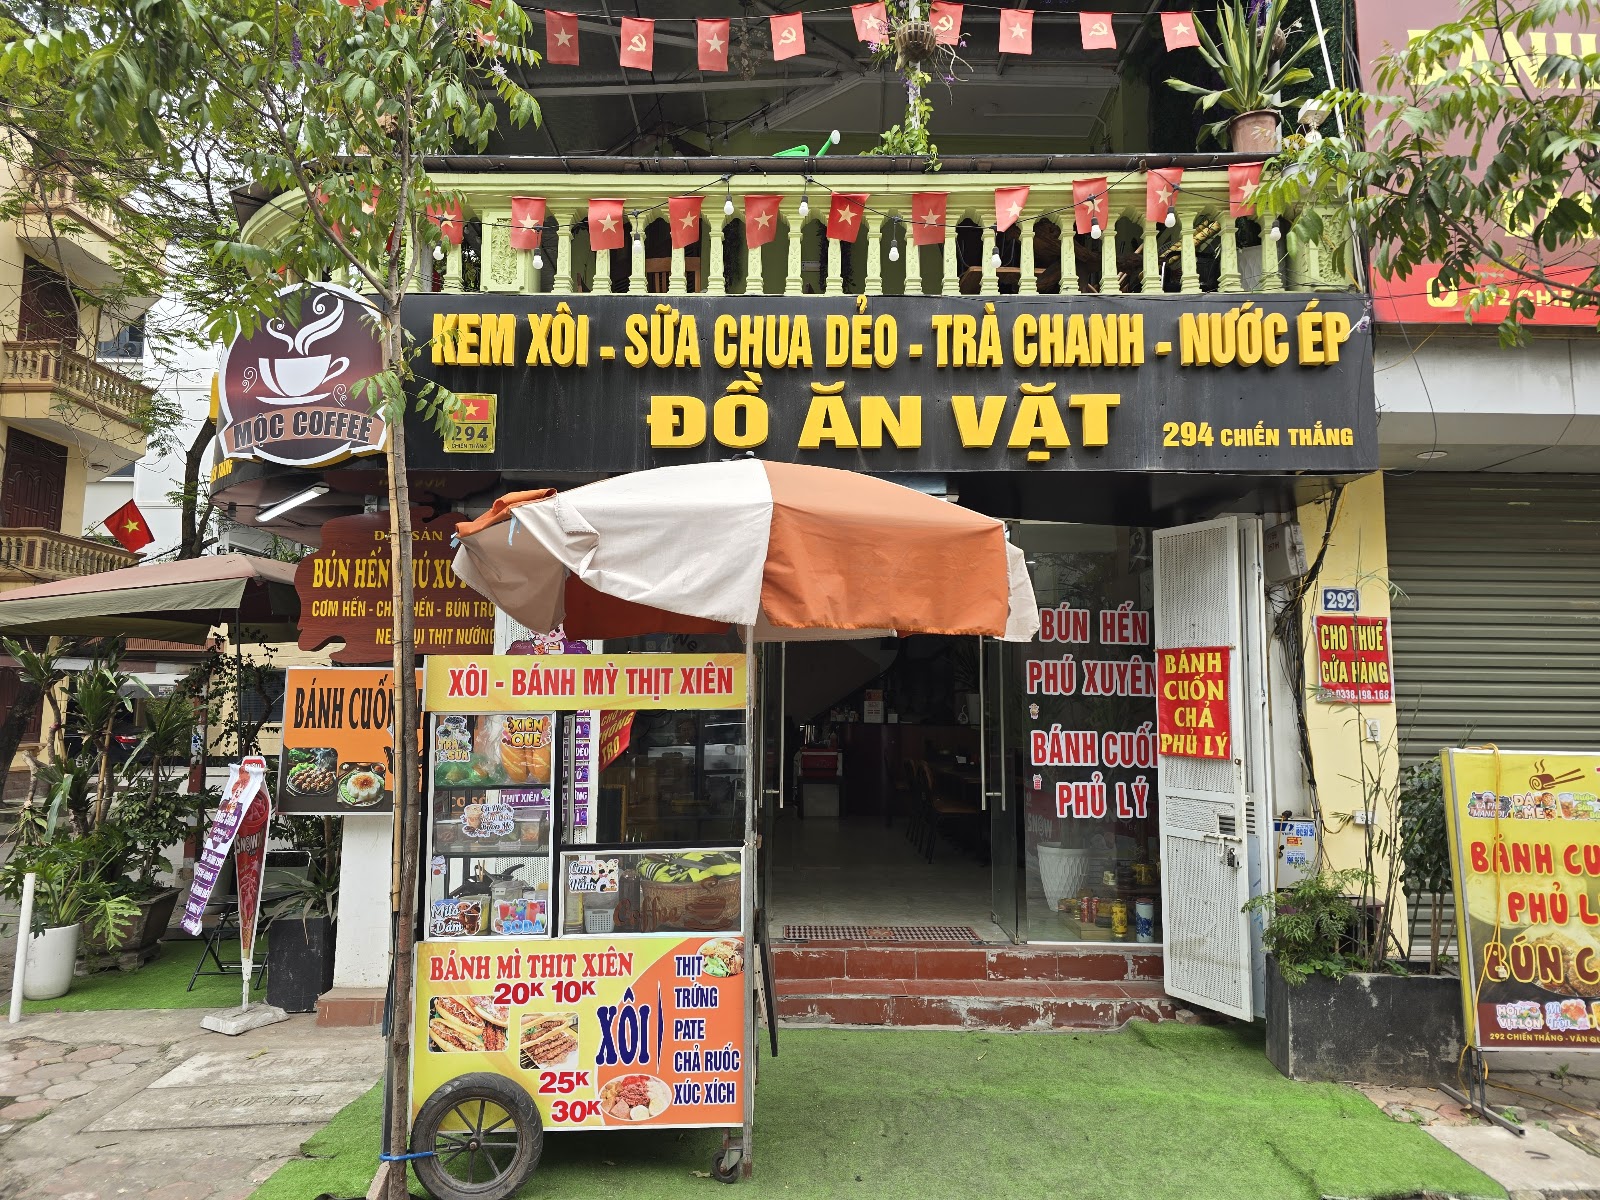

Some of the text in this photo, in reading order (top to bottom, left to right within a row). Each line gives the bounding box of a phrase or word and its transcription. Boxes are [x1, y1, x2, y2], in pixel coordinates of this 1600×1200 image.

[432, 295, 1348, 369] KEM XÔI - SỮA CHUA DẺO - TRÀ CHANH - NƯỚC ÉP
[233, 410, 374, 448] MỘC COFFEE
[647, 371, 1121, 462] ĐỒ ĂN VẶT
[452, 426, 488, 441] 294
[1163, 420, 1354, 447] 294 CHIẾN THẮNG
[313, 550, 350, 588] BÚN
[354, 547, 390, 588] HẾN
[312, 599, 339, 617] CƠM
[342, 596, 366, 617] HẾN
[445, 598, 469, 617] BÚN
[1326, 591, 1356, 609] 292
[1040, 602, 1148, 644] BÚN HẾN
[1321, 620, 1384, 651] CHO THUÊ
[429, 628, 453, 648] THỊT
[1028, 655, 1075, 694] PHÚ
[1165, 650, 1222, 674] BÁNH
[1321, 654, 1389, 683] CỬA HÀNG
[449, 663, 488, 697] XÔI
[511, 662, 576, 697] BÁNH
[583, 662, 620, 696] MỲ
[625, 667, 674, 701] THỊT
[680, 661, 734, 695] XIÊN
[1164, 674, 1224, 701] CUỐN
[294, 677, 346, 729] BÁNH
[1174, 701, 1215, 729] CHẢ
[511, 717, 543, 733] XIÊN
[511, 732, 542, 748] QUE
[1033, 725, 1097, 765] BÁNH
[1160, 729, 1229, 756] PHỦ LÝ
[501, 793, 520, 806] THỊT
[521, 791, 540, 804] XIÊN
[1058, 774, 1148, 816] PHỦ LÝ
[1471, 834, 1554, 875] BÁNH
[613, 896, 682, 932] Coffee
[1507, 881, 1569, 925] PHỦ
[502, 920, 545, 934] SODA
[430, 950, 491, 981] BÁNH
[496, 948, 521, 979] MÌ
[581, 946, 634, 977] XIÊN
[675, 955, 703, 983] THỊT
[1484, 935, 1564, 983] BÚN
[493, 980, 597, 1005] 20K 10K
[674, 985, 718, 1009] TRỨNG
[596, 987, 650, 1065] XÔI
[674, 1019, 705, 1040] PATE
[1507, 1032, 1533, 1041] CHIẾN
[1534, 1032, 1563, 1042] THẮNG
[1570, 1034, 1588, 1042] VĂN
[674, 1042, 740, 1073] CHẢ RUỐC
[539, 1071, 589, 1094] 25K
[673, 1077, 736, 1105] XÚC XÍCH
[552, 1100, 602, 1122] 30K
